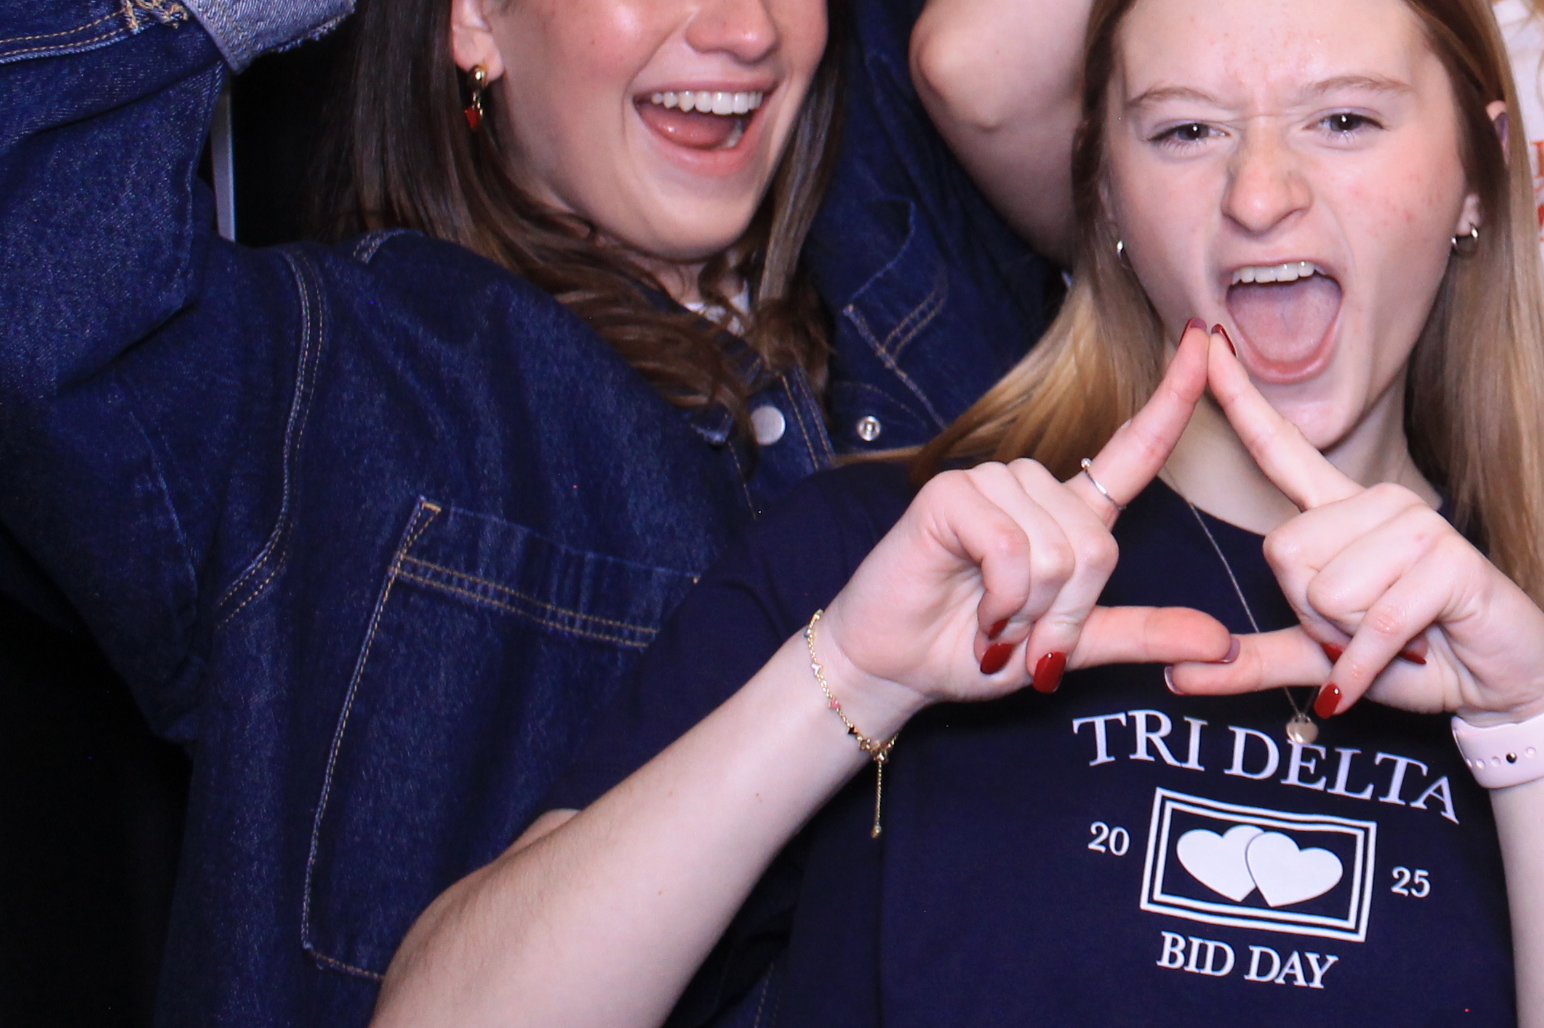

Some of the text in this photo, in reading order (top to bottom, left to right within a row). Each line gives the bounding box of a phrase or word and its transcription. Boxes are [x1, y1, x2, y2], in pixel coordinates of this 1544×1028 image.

[1072, 710, 1460, 825] TRI DELTA
[1088, 822, 1431, 898] 20 25
[1156, 931, 1339, 989] BID DAY
